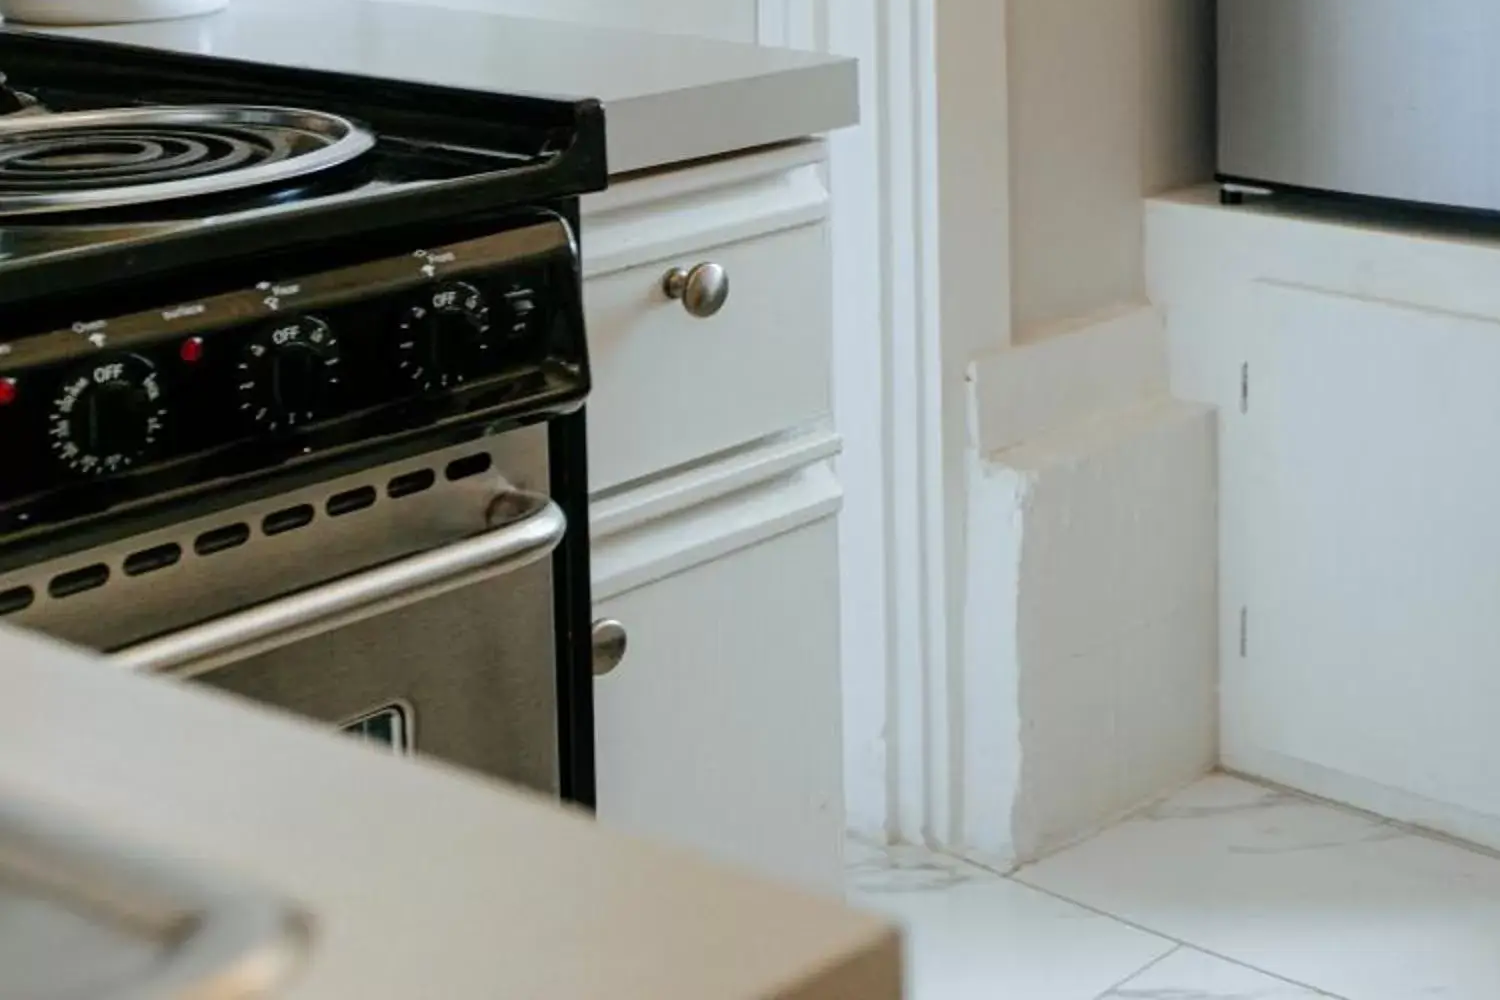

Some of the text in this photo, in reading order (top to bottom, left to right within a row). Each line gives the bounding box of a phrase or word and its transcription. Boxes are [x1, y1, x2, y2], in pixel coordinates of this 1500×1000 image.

[432, 291, 457, 308] OFF
[272, 325, 300, 345] OFF
[93, 363, 124, 383] OFF
